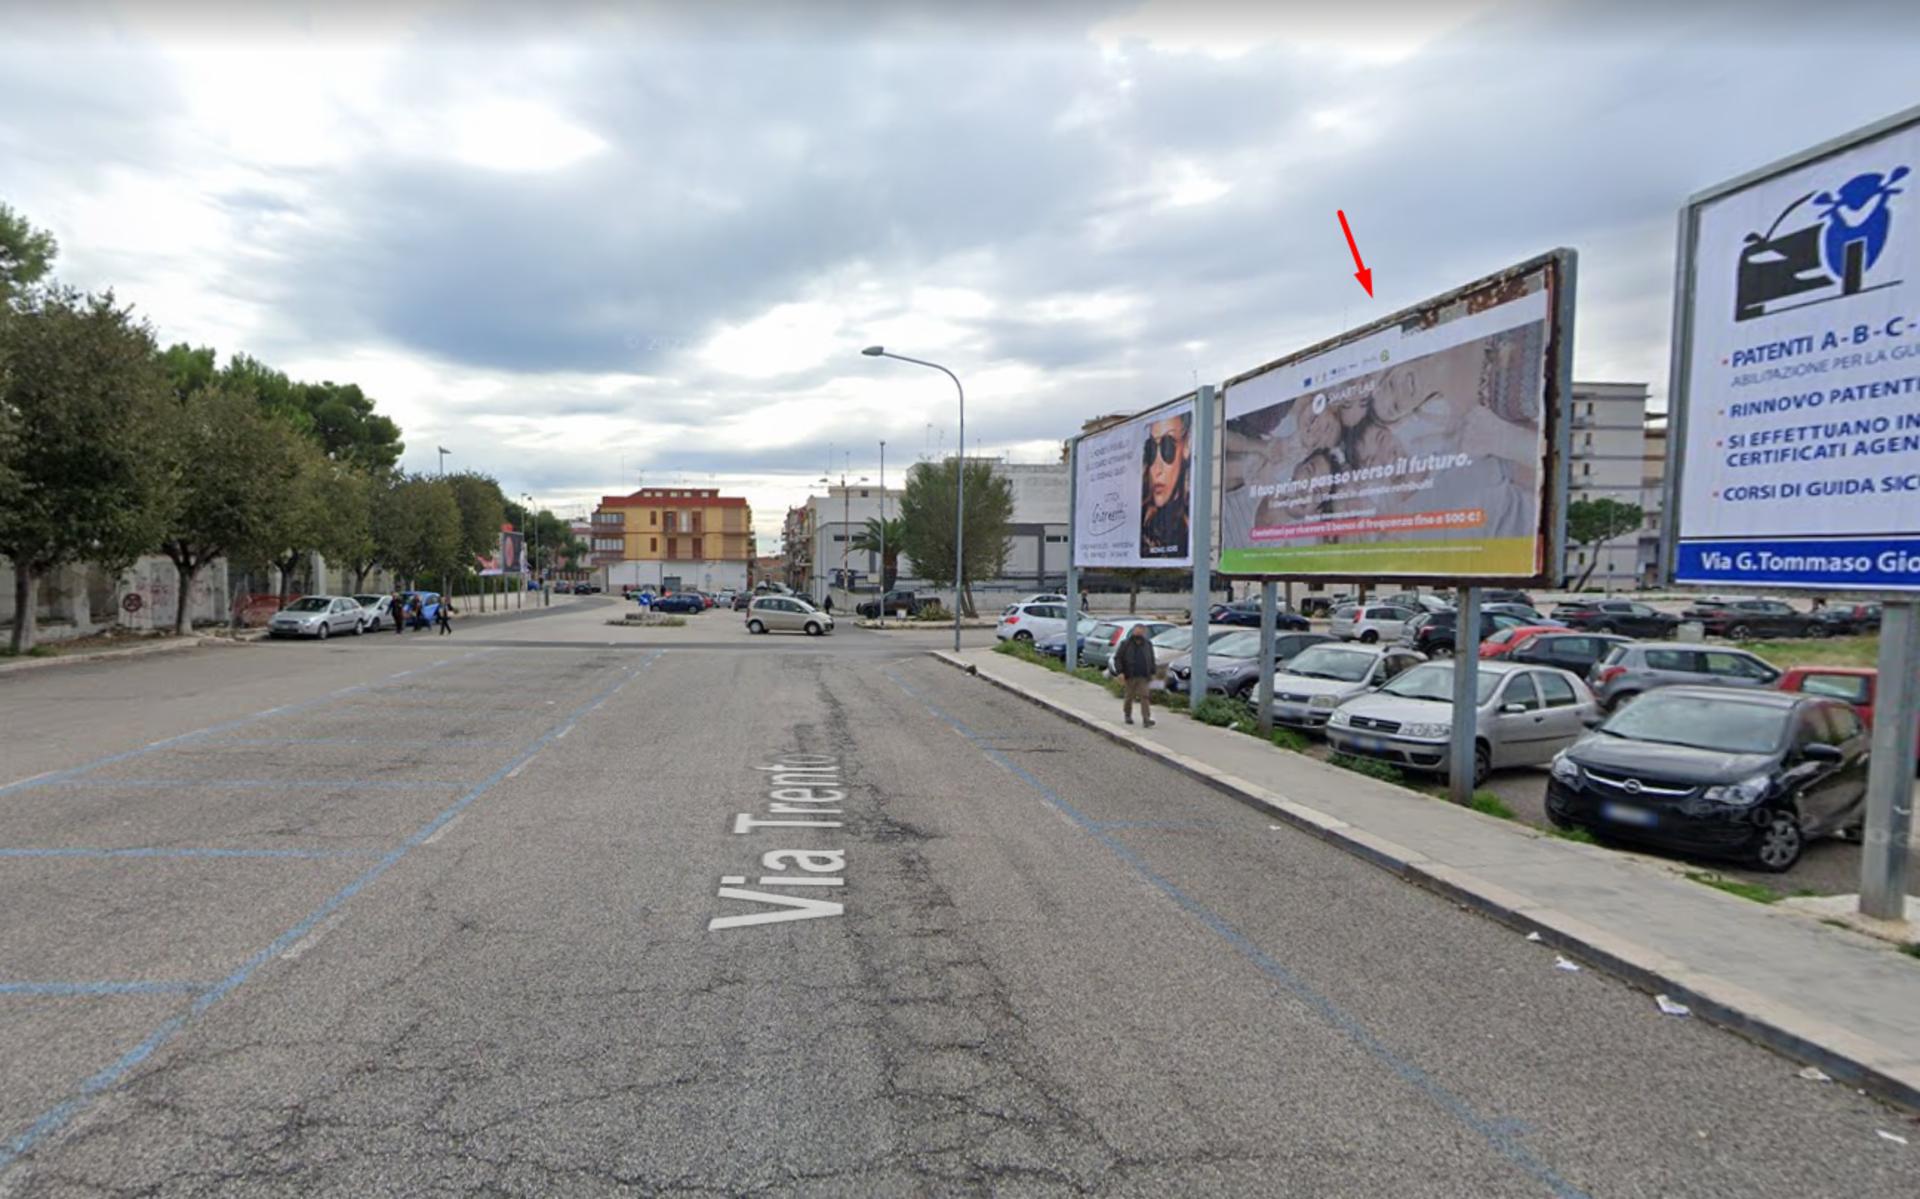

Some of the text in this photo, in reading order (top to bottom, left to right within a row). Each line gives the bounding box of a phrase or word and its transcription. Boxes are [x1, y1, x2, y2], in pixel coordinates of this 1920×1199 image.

[1732, 336, 1814, 368] PATENTI
[1832, 353, 1862, 371] PER
[1865, 348, 1888, 367] LA
[1730, 391, 1824, 418] RINNOVO
[1728, 434, 1745, 450] SI
[1750, 416, 1889, 447] EFFETTUANO
[1726, 445, 1846, 468] CERTIFICATI
[1274, 478, 1308, 499] primo
[1310, 473, 1351, 493] passo
[1352, 463, 1394, 482] verso
[1395, 457, 1408, 475] il
[1408, 452, 1473, 475] futuro.
[1723, 484, 1776, 501] CORSI
[1781, 483, 1801, 498] DI
[1806, 477, 1875, 497] GUIDA
[1701, 552, 1731, 571] Via
[1877, 550, 1920, 573] Gio
